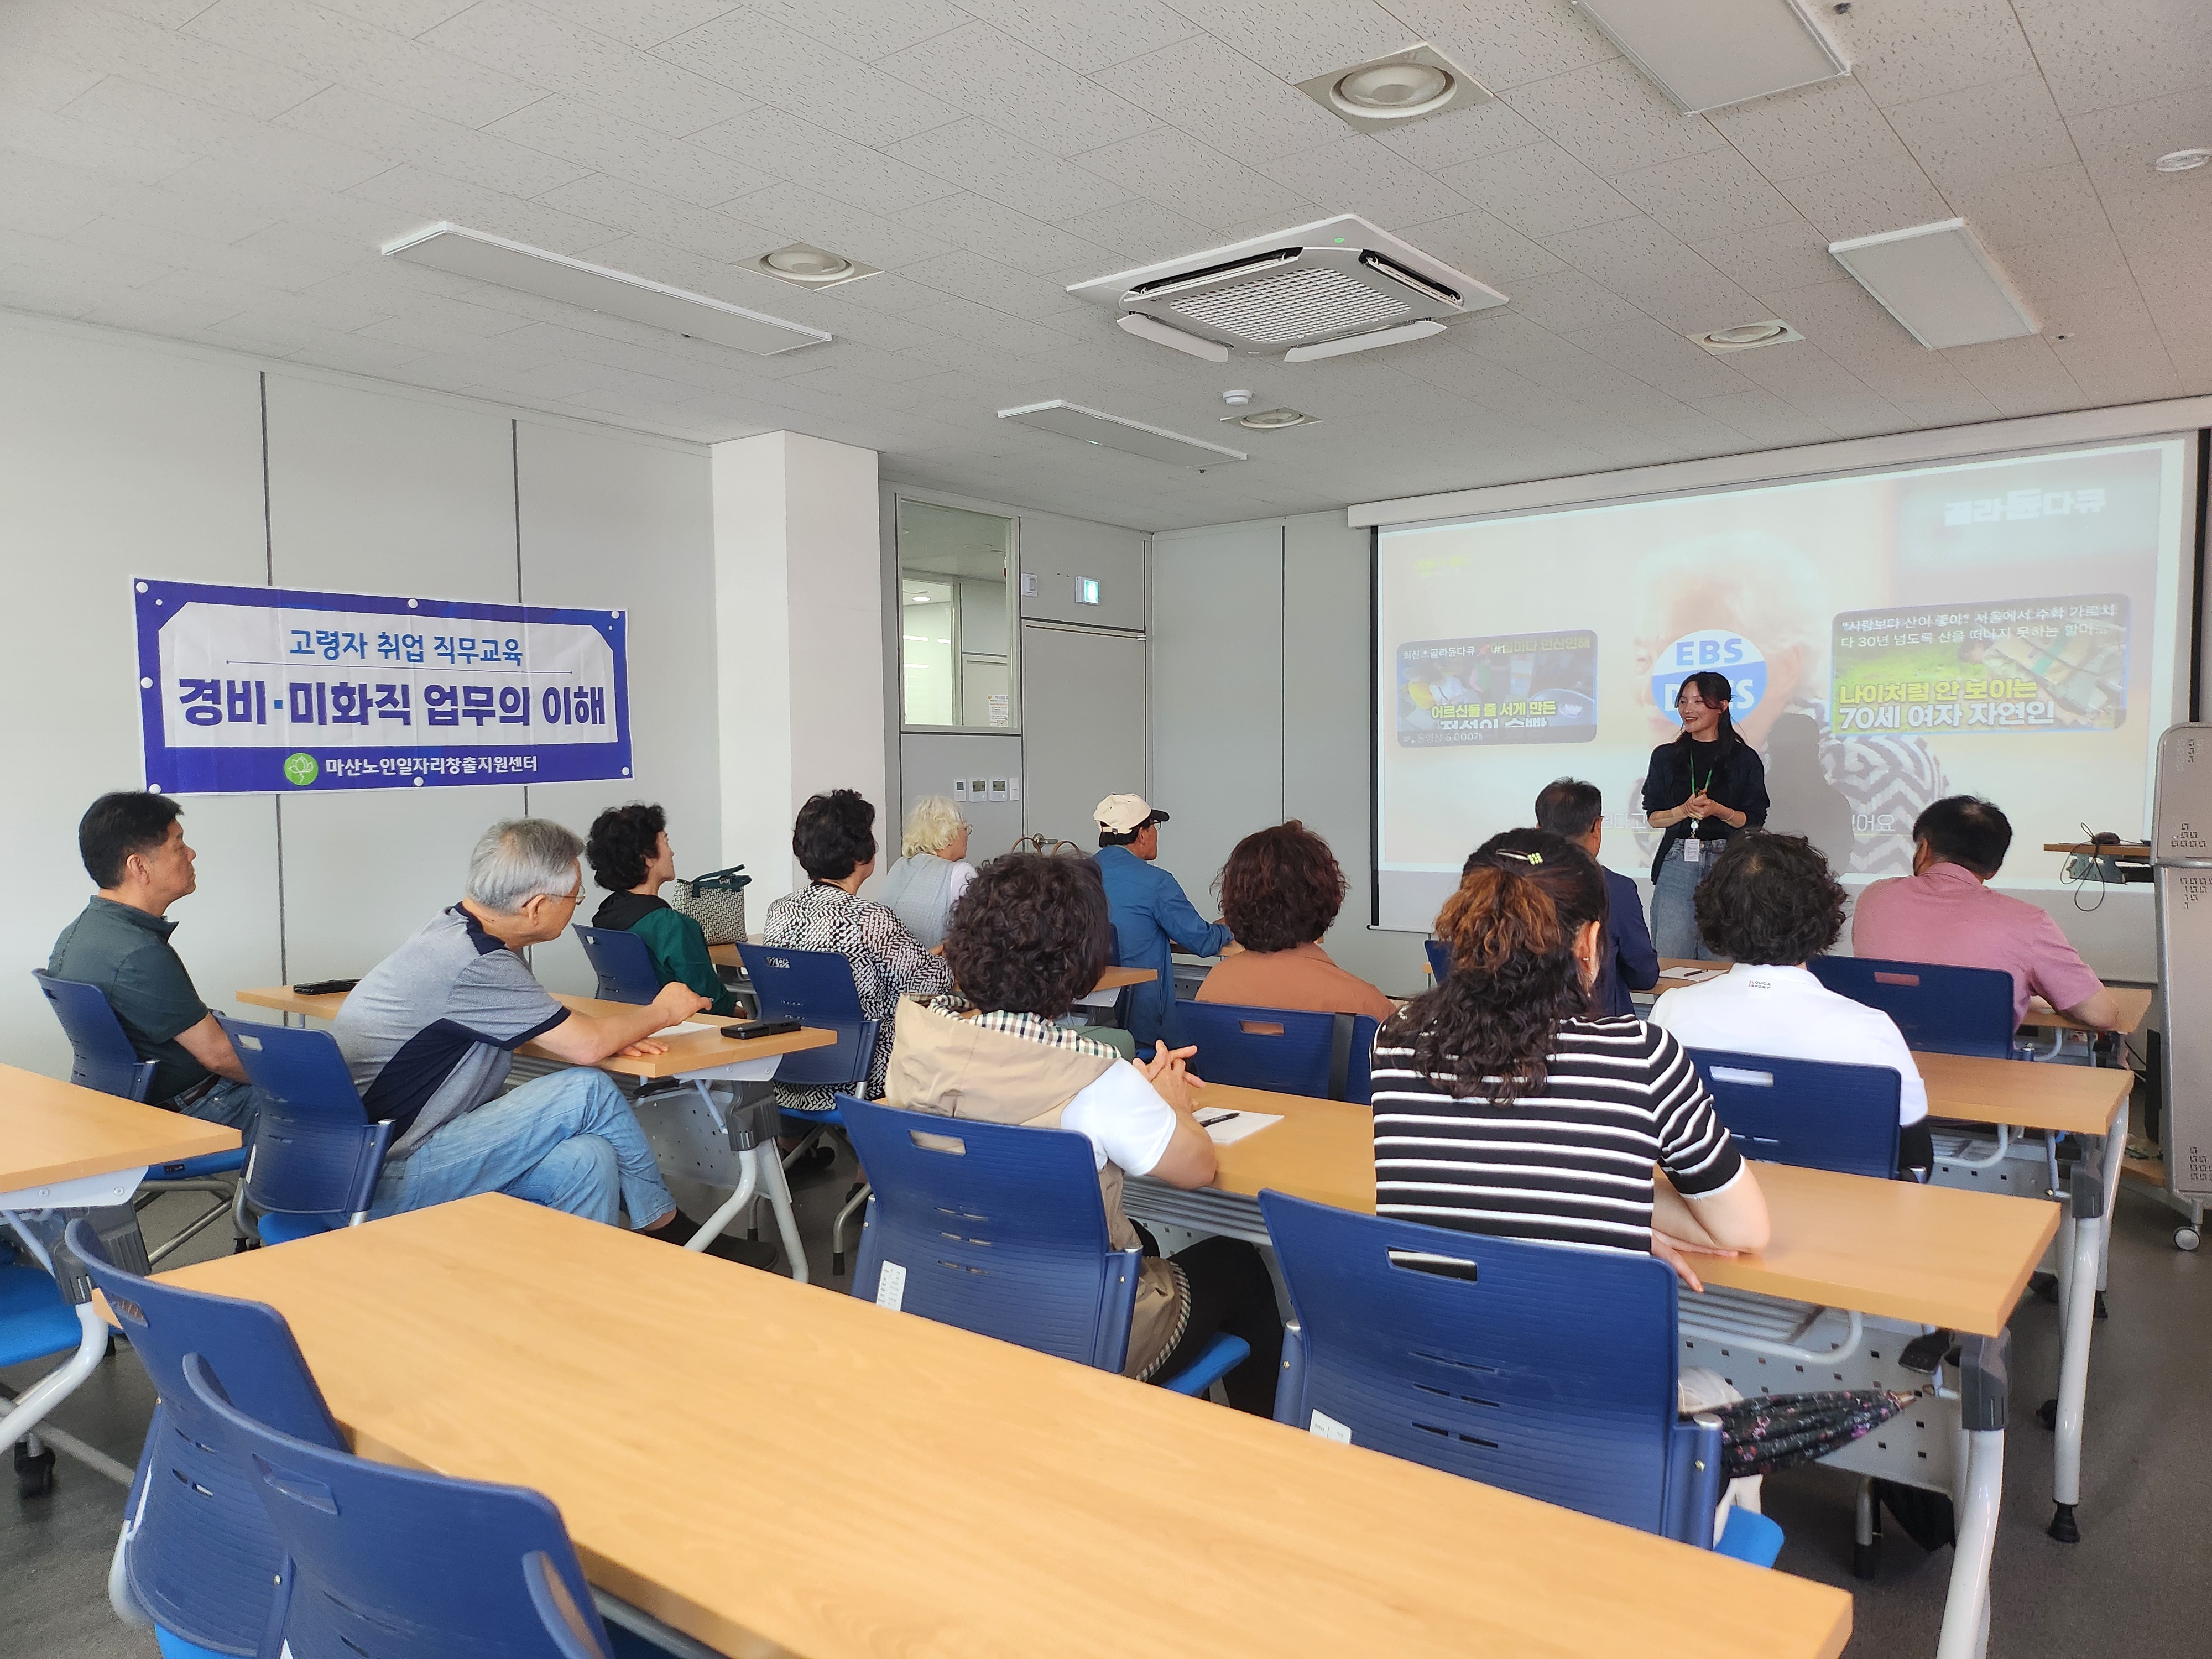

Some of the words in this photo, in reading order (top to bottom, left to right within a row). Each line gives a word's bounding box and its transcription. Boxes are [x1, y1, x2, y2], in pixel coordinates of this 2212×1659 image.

[1903, 615, 1931, 629] 산이
[1975, 609, 2030, 624] 서울에서
[2070, 603, 2114, 618] 가르치
[290, 630, 368, 660] 고령자
[377, 632, 424, 663] 취업
[434, 635, 523, 667] 직무교육
[1841, 637, 1854, 649] 다
[1858, 634, 1888, 647] 30년
[1893, 632, 1933, 645] 넘도록
[1938, 630, 1965, 643] 산을
[1969, 627, 2011, 641] 떠나지
[2016, 625, 2059, 638] 못하는
[1403, 649, 1420, 660] 최신
[1494, 645, 1505, 653] #1
[1676, 638, 1743, 666] EBS
[179, 679, 411, 726] 경비·미화직
[424, 685, 530, 726] 업무의
[542, 686, 606, 725] 이해
[1840, 682, 1929, 705] 나이처럼
[1936, 681, 1960, 701] 안
[1964, 678, 2037, 699] 보이는
[1431, 703, 1480, 719] 어르신들
[1484, 703, 1496, 717] 줄
[1500, 701, 1526, 716] 서게
[1529, 700, 1557, 716] 만든
[1839, 705, 1901, 730] 70세
[1908, 703, 1963, 727] 여자
[1968, 700, 2054, 726] 자연인
[1417, 732, 1442, 743] 동영상
[1446, 732, 1483, 743] 5,000개
[326, 755, 538, 776] 마산노인일자리창출지원센터
